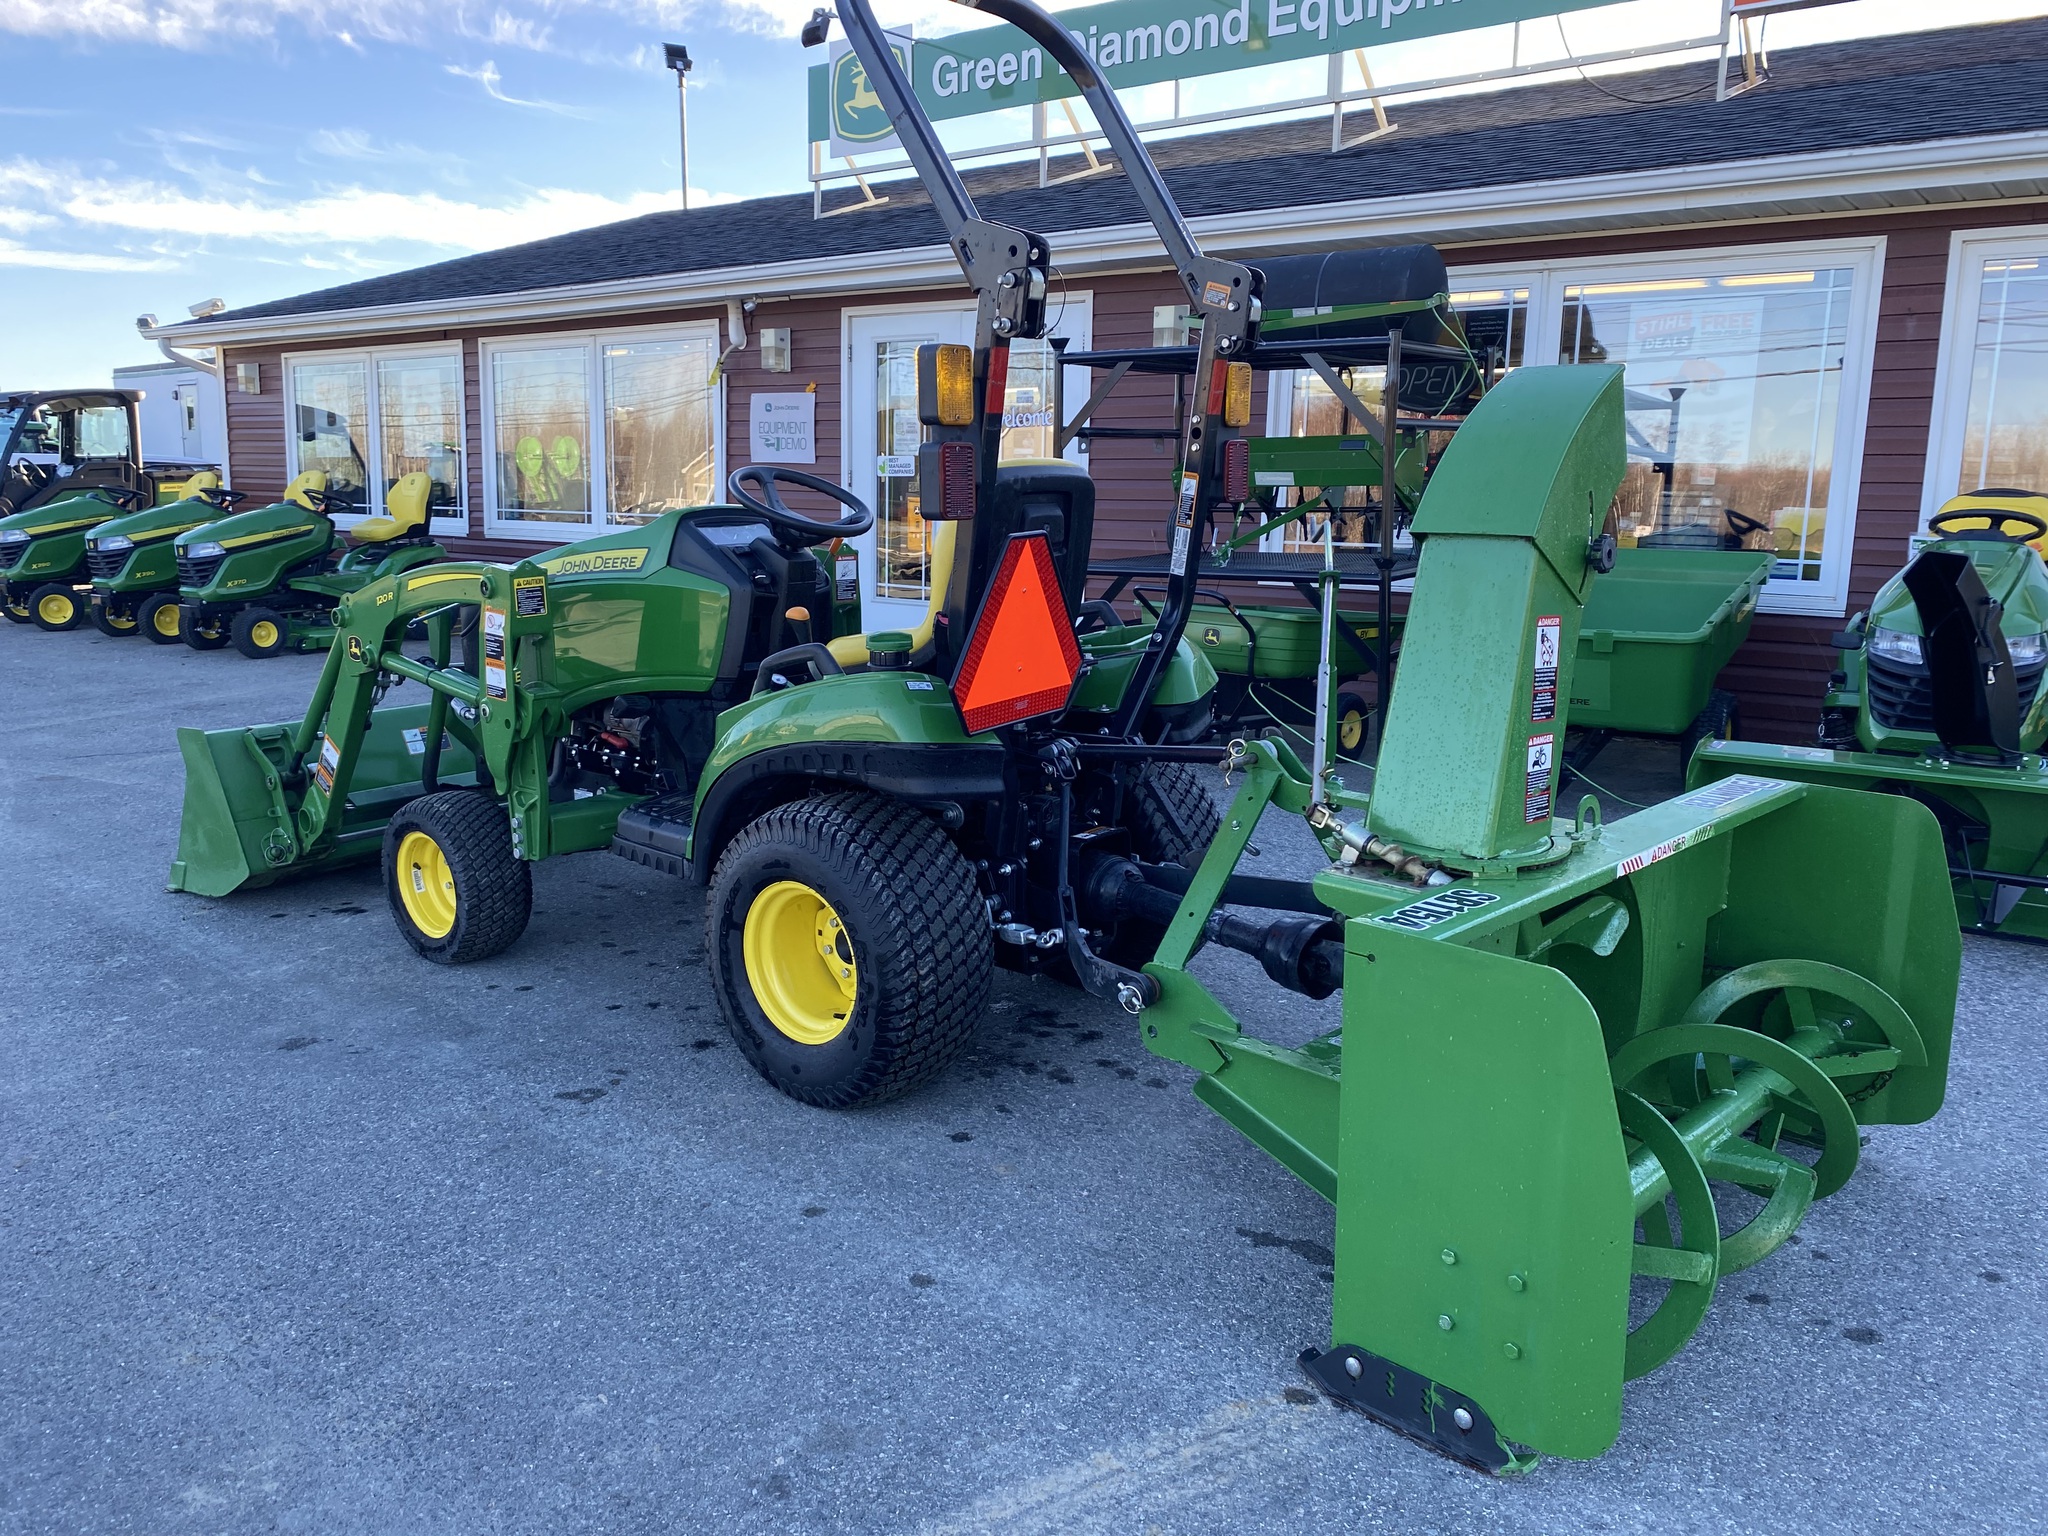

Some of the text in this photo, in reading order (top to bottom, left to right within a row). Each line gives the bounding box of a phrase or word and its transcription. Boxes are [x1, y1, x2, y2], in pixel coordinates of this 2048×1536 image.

[932, 47, 1043, 97] Green
[1268, 0, 1461, 40] Equp
[1637, 314, 1688, 335] STIHL
[1701, 312, 1755, 330] FREE
[1644, 335, 1689, 350] DEALS
[1398, 365, 1460, 394] OPEN
[1001, 406, 1054, 428] elcome
[758, 421, 807, 434] EQUIPMENT
[780, 437, 807, 450] DEMO
[556, 556, 638, 574] JOHN DEERE
[226, 578, 247, 587] X370
[522, 578, 544, 586] CAUTION
[1542, 617, 1560, 626] DANGER
[1533, 734, 1554, 746] DANGER
[1657, 836, 1687, 859] DANGER
[1376, 888, 1499, 930] SB1154
